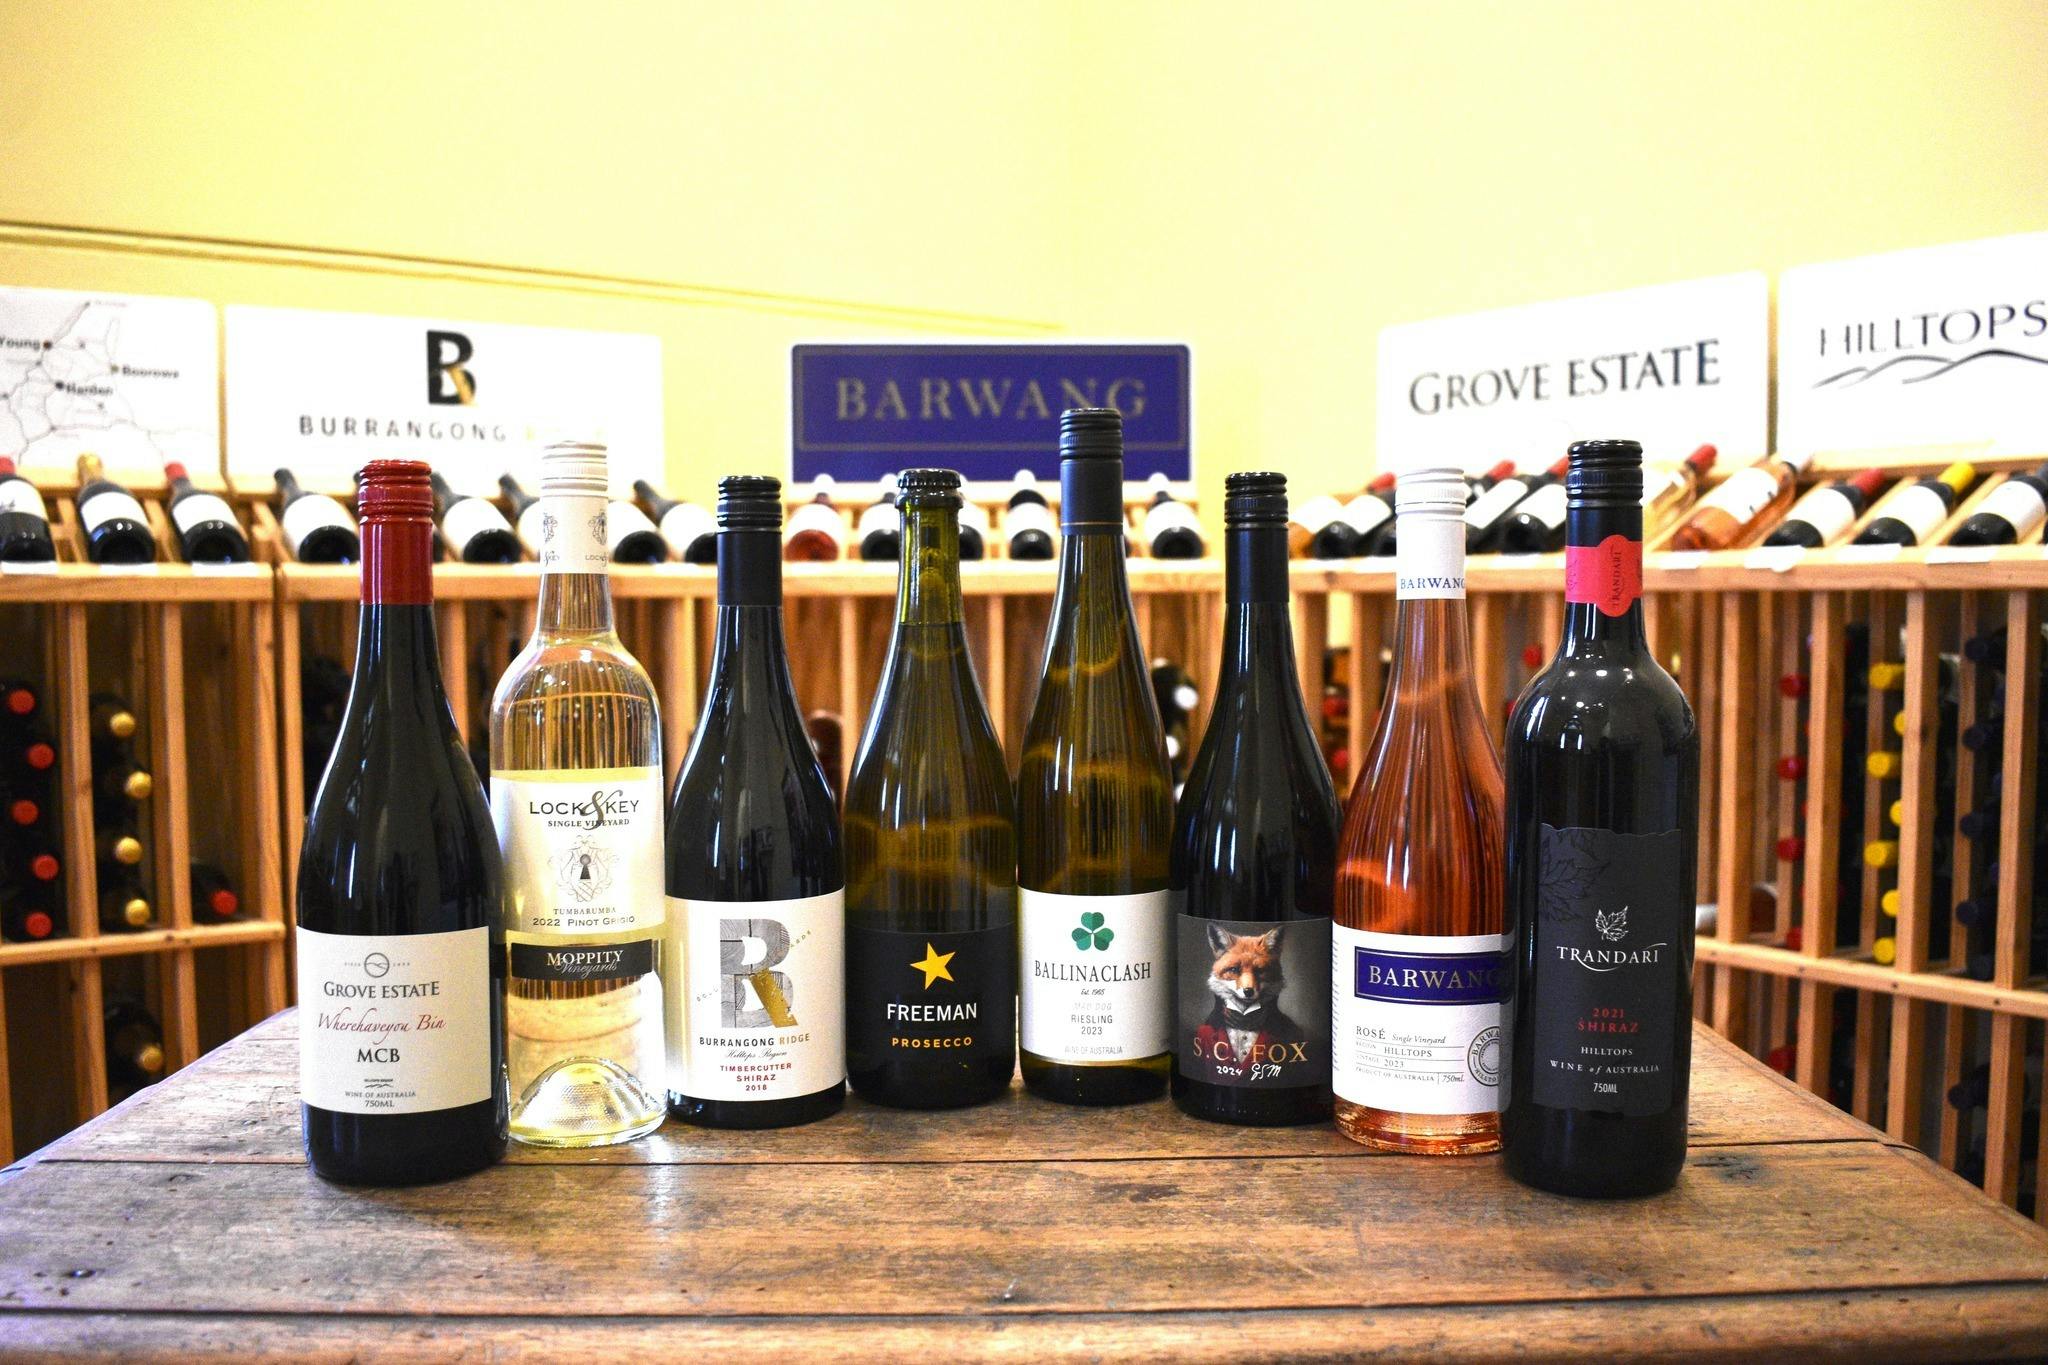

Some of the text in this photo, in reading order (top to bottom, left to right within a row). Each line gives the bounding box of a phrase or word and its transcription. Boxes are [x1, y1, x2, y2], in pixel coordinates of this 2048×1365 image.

[1820, 300, 2047, 357] HILLTOPS
[1408, 339, 1720, 415] GROVE ESTATE
[836, 377, 1147, 420] BARWANG
[299, 414, 507, 442] BURRANGONG
[547, 818, 630, 828] SINGLE VINEYARD
[553, 907, 617, 916] TUMBARUMBA
[532, 915, 636, 927] 2022 PINOT GRIGIO
[547, 950, 624, 966] MOPPITY
[1557, 944, 1663, 971] TRANDARI
[556, 957, 619, 979] Vineyards
[1035, 960, 1151, 982] BALLINACLASH
[324, 981, 441, 999] GROVE ESTATE
[887, 1003, 977, 1022] FREEMAN
[1071, 1014, 1113, 1024] RIESLING
[1592, 1008, 1625, 1018] 2021
[416, 1014, 448, 1031] Bin
[1577, 1020, 1639, 1033] SHIRAZ
[1081, 1026, 1103, 1035] 2023
[1356, 1025, 1386, 1040] ROSÉ
[699, 1033, 811, 1047] BURRANGONG RIDGE
[892, 1037, 972, 1048] PROSECCO
[356, 1048, 401, 1063] MCB
[1251, 1041, 1308, 1064] FOX
[1384, 1047, 1433, 1058] HILLTOPS
[1581, 1046, 1633, 1056] HILLTOPS
[720, 1063, 792, 1072] TIMBERCUTTER
[1384, 1059, 1404, 1068] 2023
[1550, 1059, 1660, 1075] WINE of AUSTRALIA
[1216, 1065, 1243, 1076] 2024
[1394, 1072, 1435, 1081] AUSTRALIA
[736, 1074, 777, 1082] SHIRAZ
[375, 1090, 417, 1099] AUSTRALIA
[745, 1084, 768, 1092] 2018
